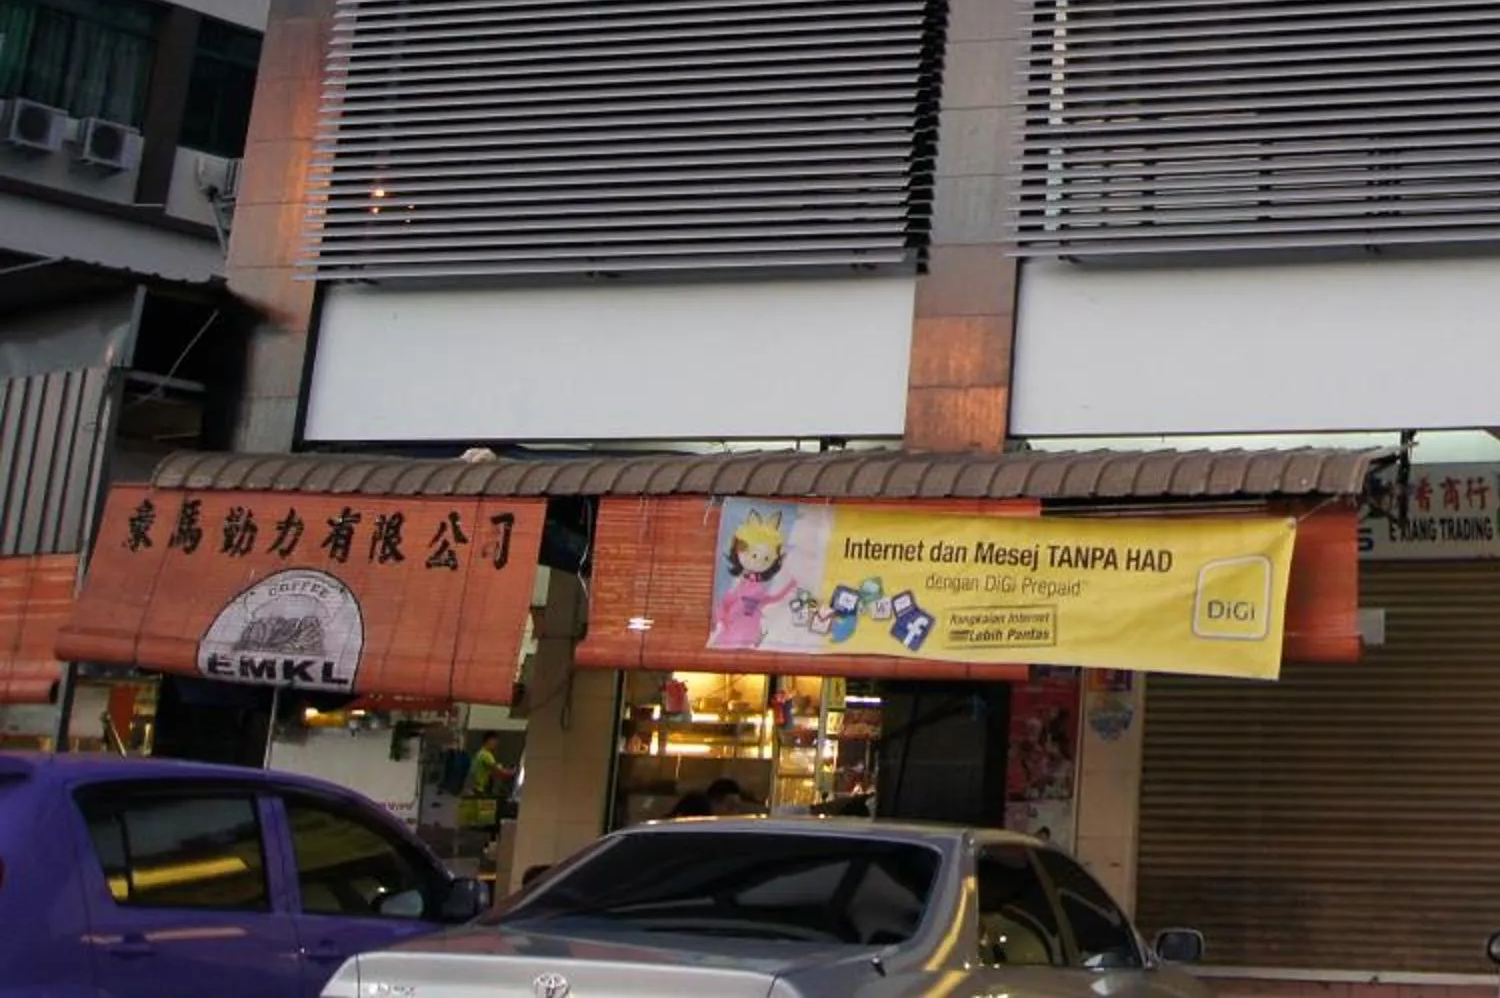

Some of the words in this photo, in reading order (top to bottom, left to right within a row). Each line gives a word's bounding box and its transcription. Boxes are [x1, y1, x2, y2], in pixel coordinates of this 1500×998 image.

[1440, 514, 1494, 543] TRADING
[843, 537, 925, 563] Internet
[929, 539, 968, 564] dan
[973, 541, 1040, 571] Mesej
[1047, 544, 1119, 571] TANPA
[1125, 548, 1173, 573] HAD
[267, 580, 330, 599] COFFEE
[925, 573, 979, 593] dengan
[984, 575, 1017, 593] DiGi
[1207, 599, 1256, 620] DiGi
[968, 628, 1003, 642] Lebih
[1007, 626, 1050, 641] Pantas
[207, 652, 350, 685] EMKL
